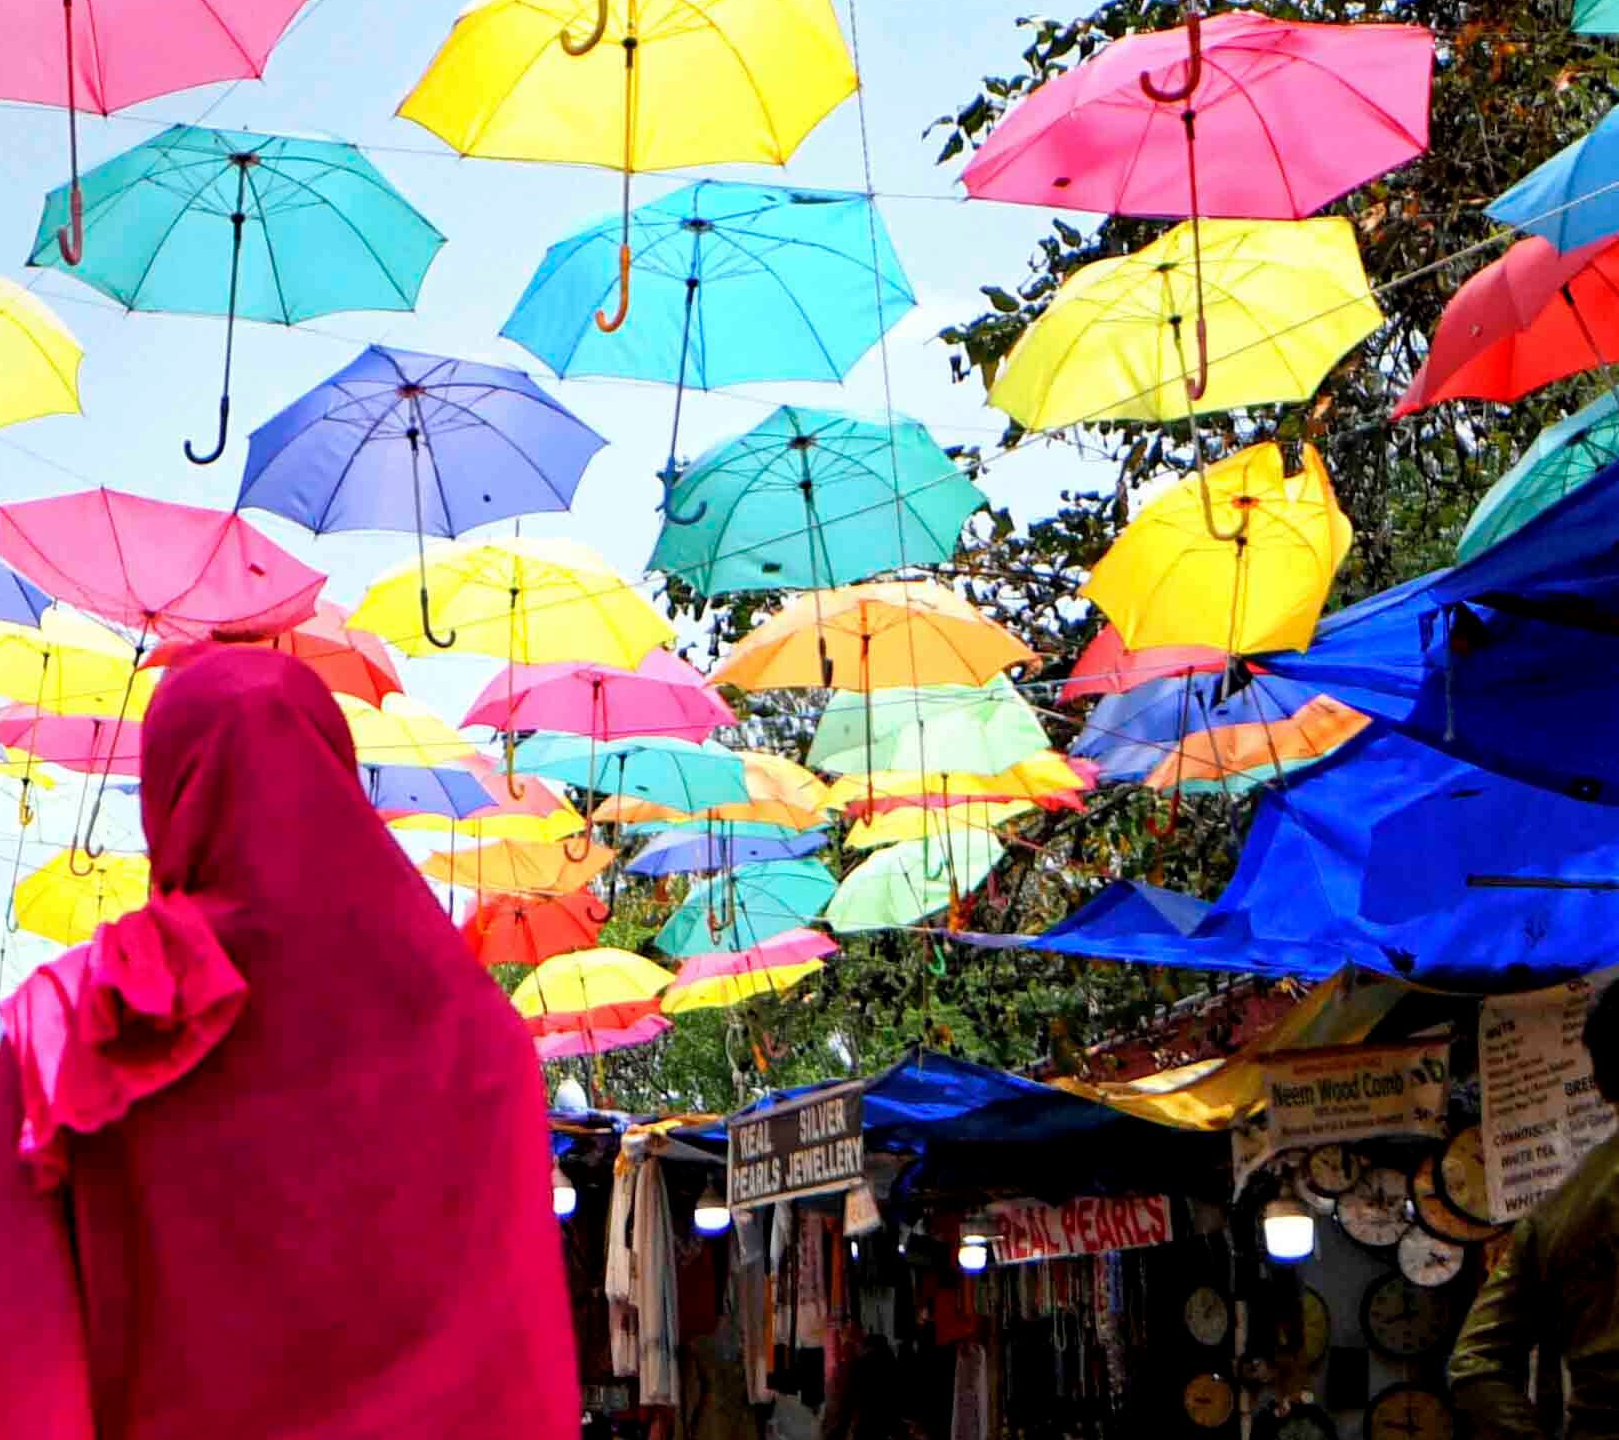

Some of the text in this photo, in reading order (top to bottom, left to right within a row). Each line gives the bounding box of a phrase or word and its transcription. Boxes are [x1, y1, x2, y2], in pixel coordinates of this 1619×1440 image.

[1272, 1067, 1404, 1107] Neem Wood Comb
[739, 1098, 848, 1162] REAL SILVER
[733, 1137, 863, 1202] PEARLS JEWELLERY
[1505, 1190, 1546, 1213] WHIT
[991, 1194, 1167, 1262] REAL PEARLS
